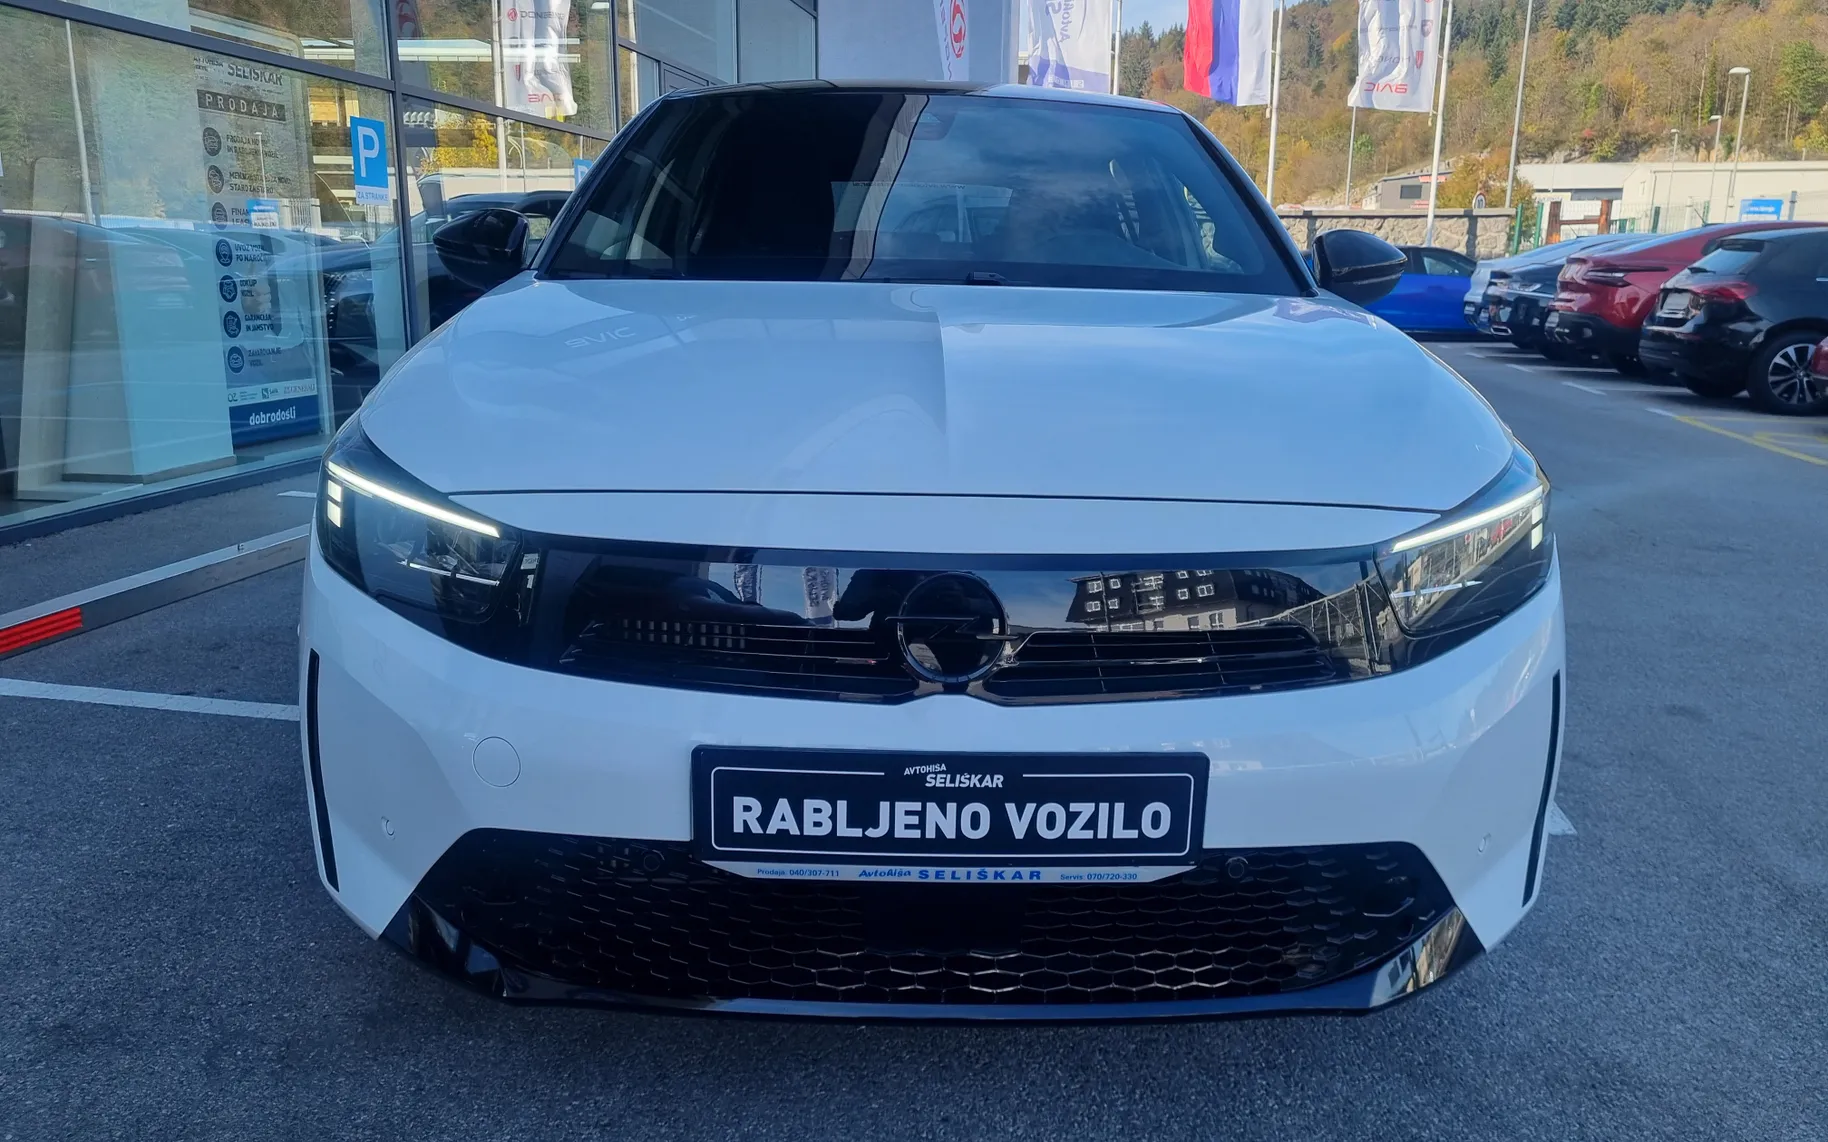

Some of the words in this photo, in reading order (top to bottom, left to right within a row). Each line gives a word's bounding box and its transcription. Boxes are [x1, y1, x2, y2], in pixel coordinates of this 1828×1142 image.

[204, 93, 279, 118] PRODAJA
[357, 125, 379, 178] P
[925, 773, 1004, 788] SELIŠKAR
[733, 796, 990, 839] RABLJENO
[1005, 802, 1171, 840] VOZILO
[789, 869, 839, 877] 040/307-711
[918, 868, 1041, 881] SELIŠKAR
[1086, 873, 1137, 881] 070/720-330
